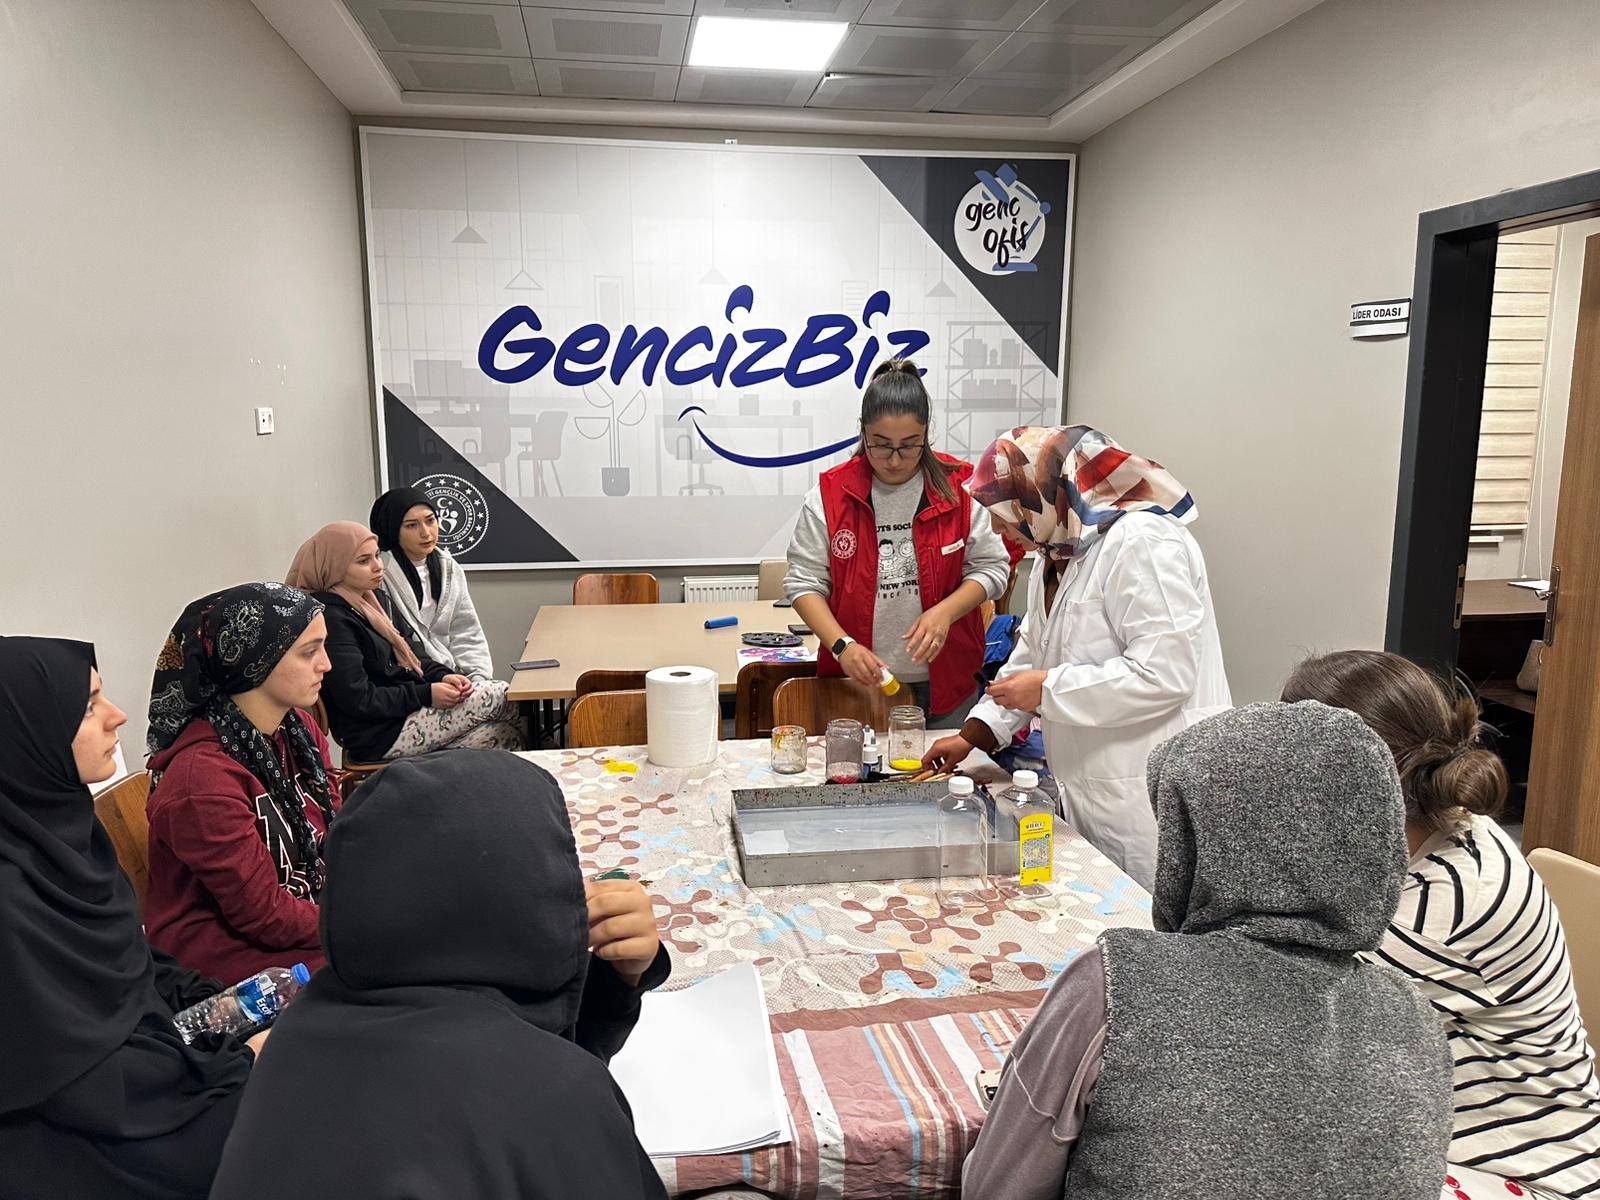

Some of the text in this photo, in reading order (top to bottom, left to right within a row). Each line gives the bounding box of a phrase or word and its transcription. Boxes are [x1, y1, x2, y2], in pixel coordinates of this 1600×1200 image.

[1352, 307, 1402, 320] LİDER ODASI
[880, 583, 899, 591] NEW
